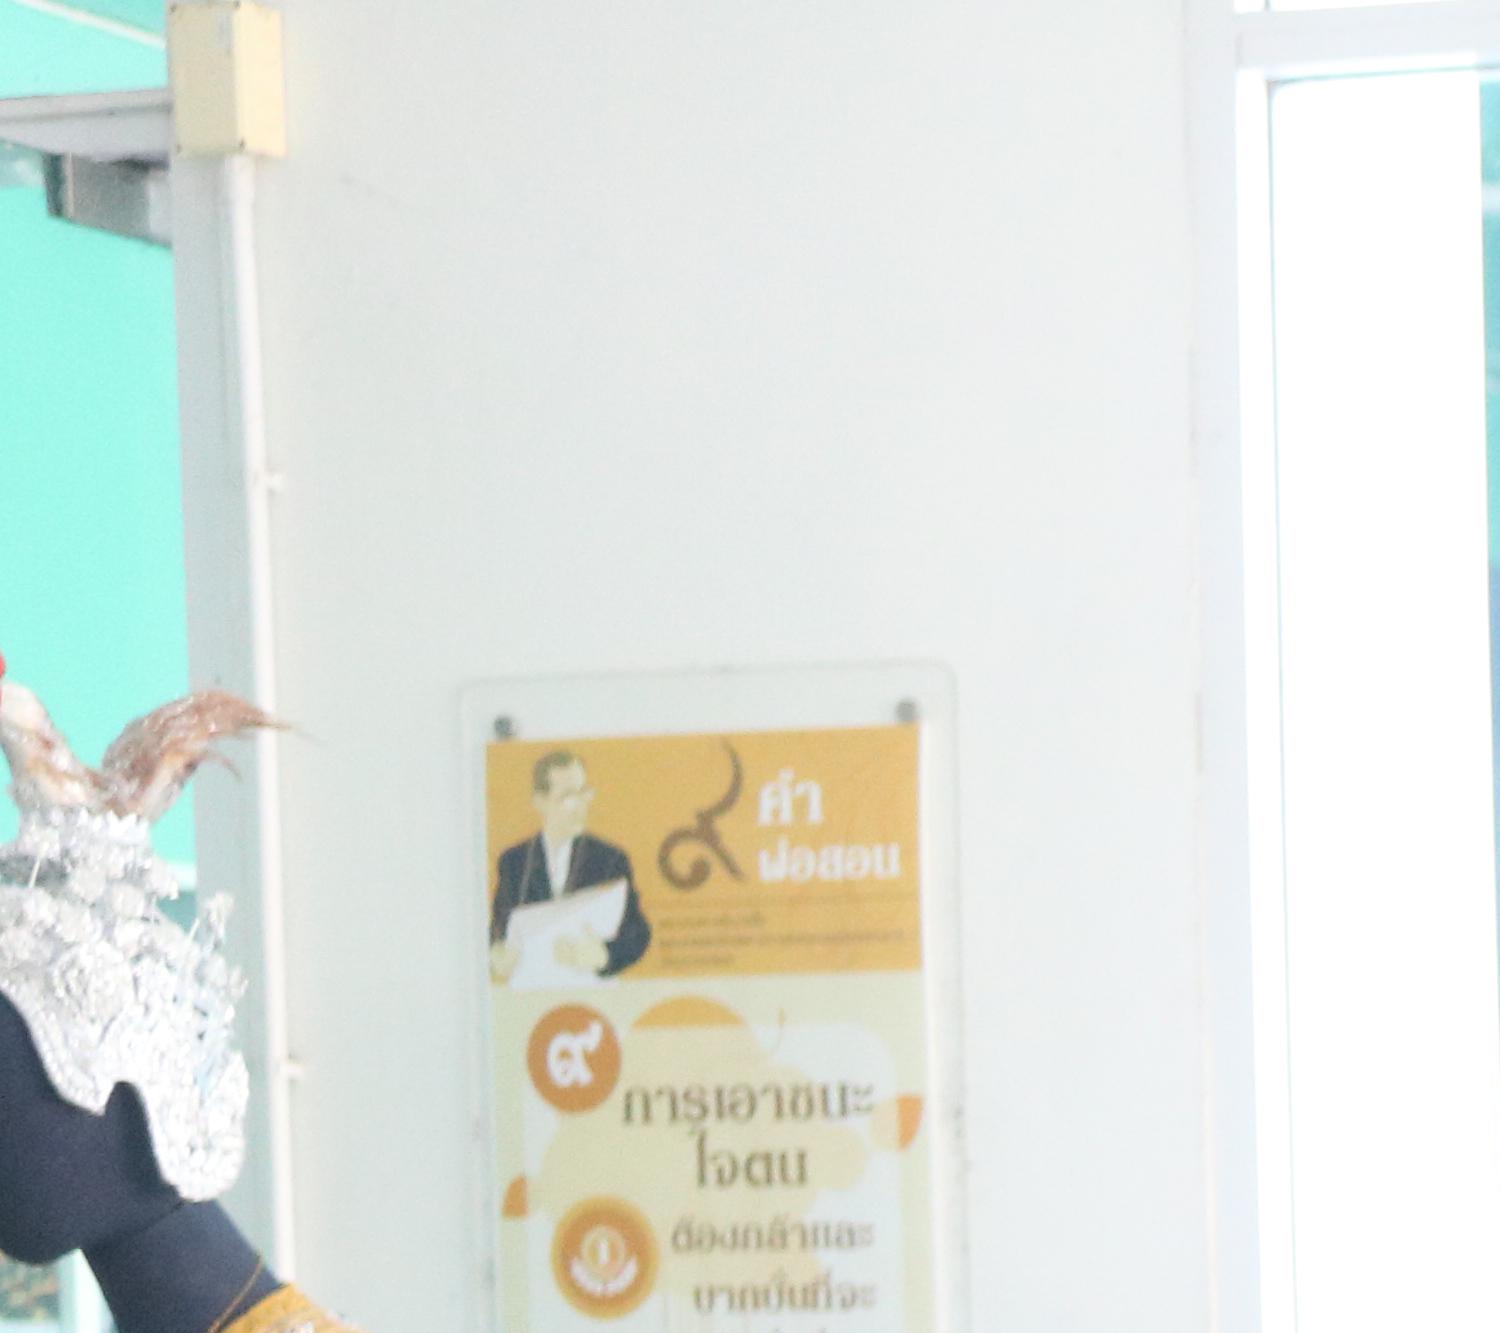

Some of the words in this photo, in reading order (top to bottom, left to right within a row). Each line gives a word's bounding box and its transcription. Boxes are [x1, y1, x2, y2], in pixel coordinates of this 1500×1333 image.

[758, 769, 824, 826] คำ
[621, 1080, 875, 1126] การเอาชนะ
